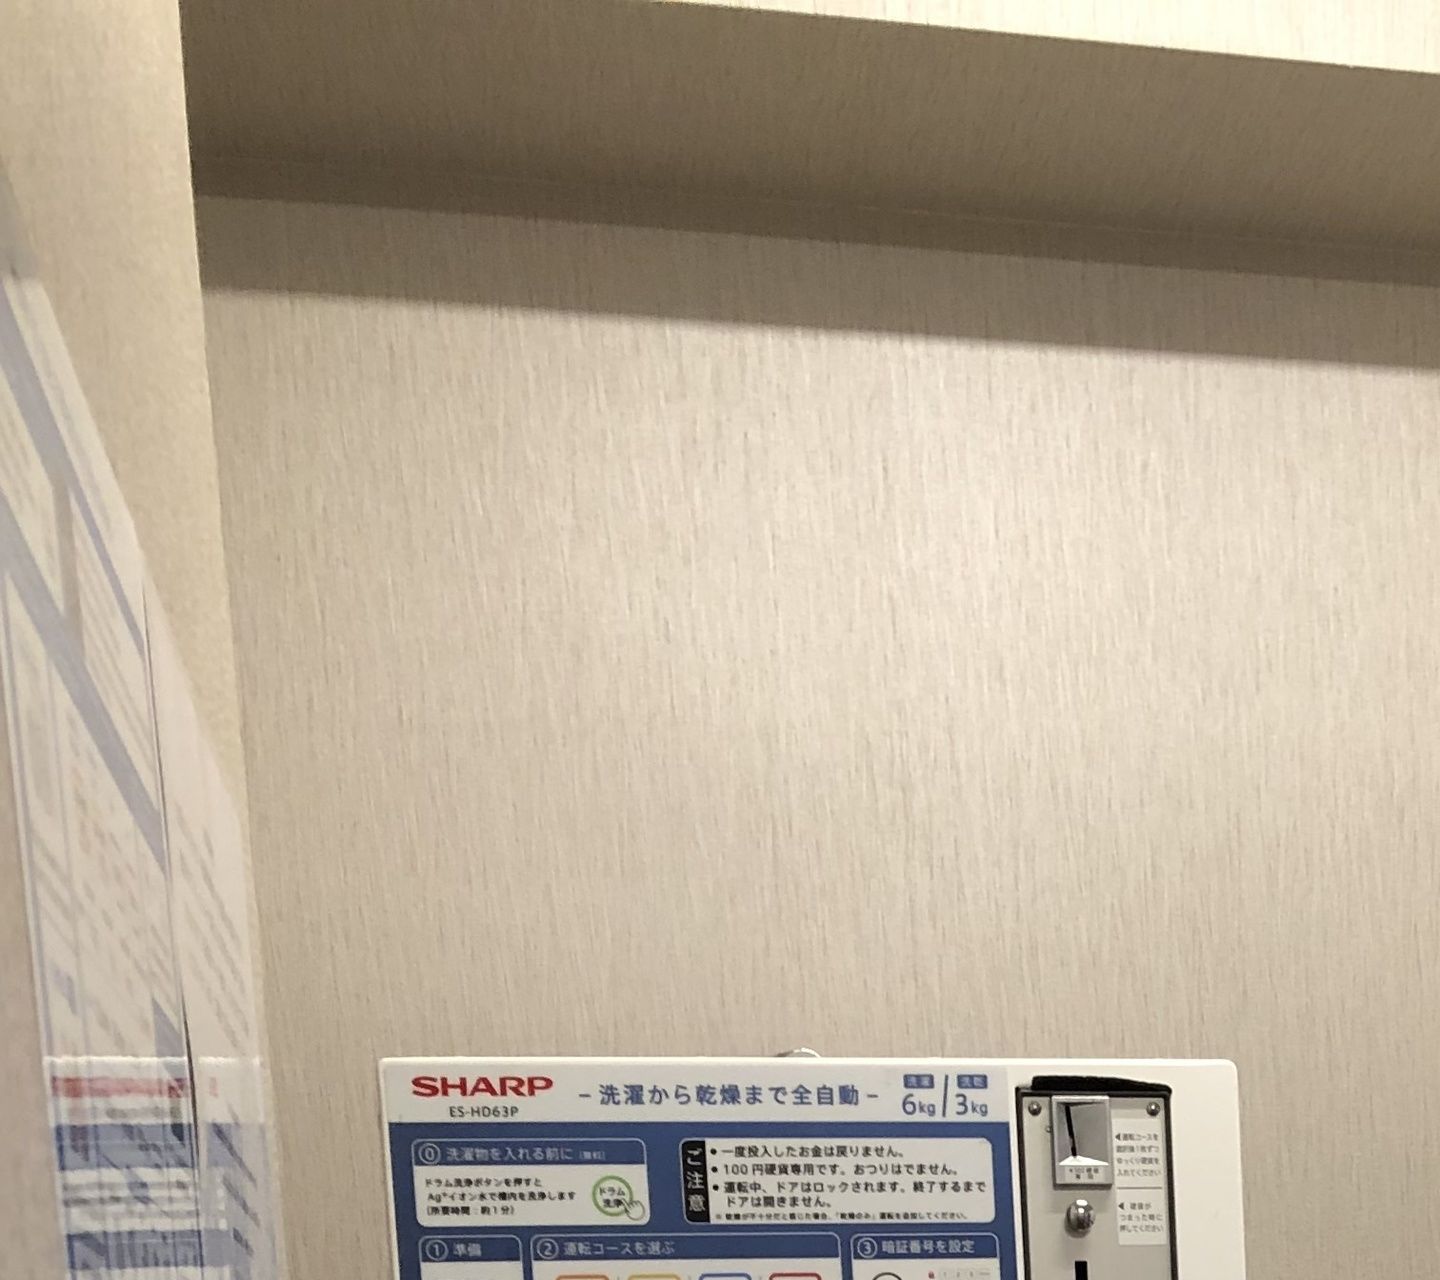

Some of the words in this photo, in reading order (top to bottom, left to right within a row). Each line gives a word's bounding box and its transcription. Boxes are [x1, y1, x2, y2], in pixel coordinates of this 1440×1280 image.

[411, 1076, 553, 1097] SHARP
[599, 1083, 860, 1107] 洗濯から乾燥まで全自動
[449, 1106, 518, 1118] ES-HD63P
[902, 1093, 936, 1117] 6kg
[955, 1093, 988, 1117] 3kg
[446, 1148, 572, 1161] 洗濯物を入れる前に
[722, 1145, 904, 1158] 一度投入したお金は戻りません。
[599, 1187, 625, 1196] ドラム
[726, 1196, 832, 1208] ドアは開きません。
[453, 1243, 482, 1257] 準備
[563, 1240, 675, 1257] 運転コースを選ぶ
[882, 1240, 975, 1254] 暗証番号を設定
